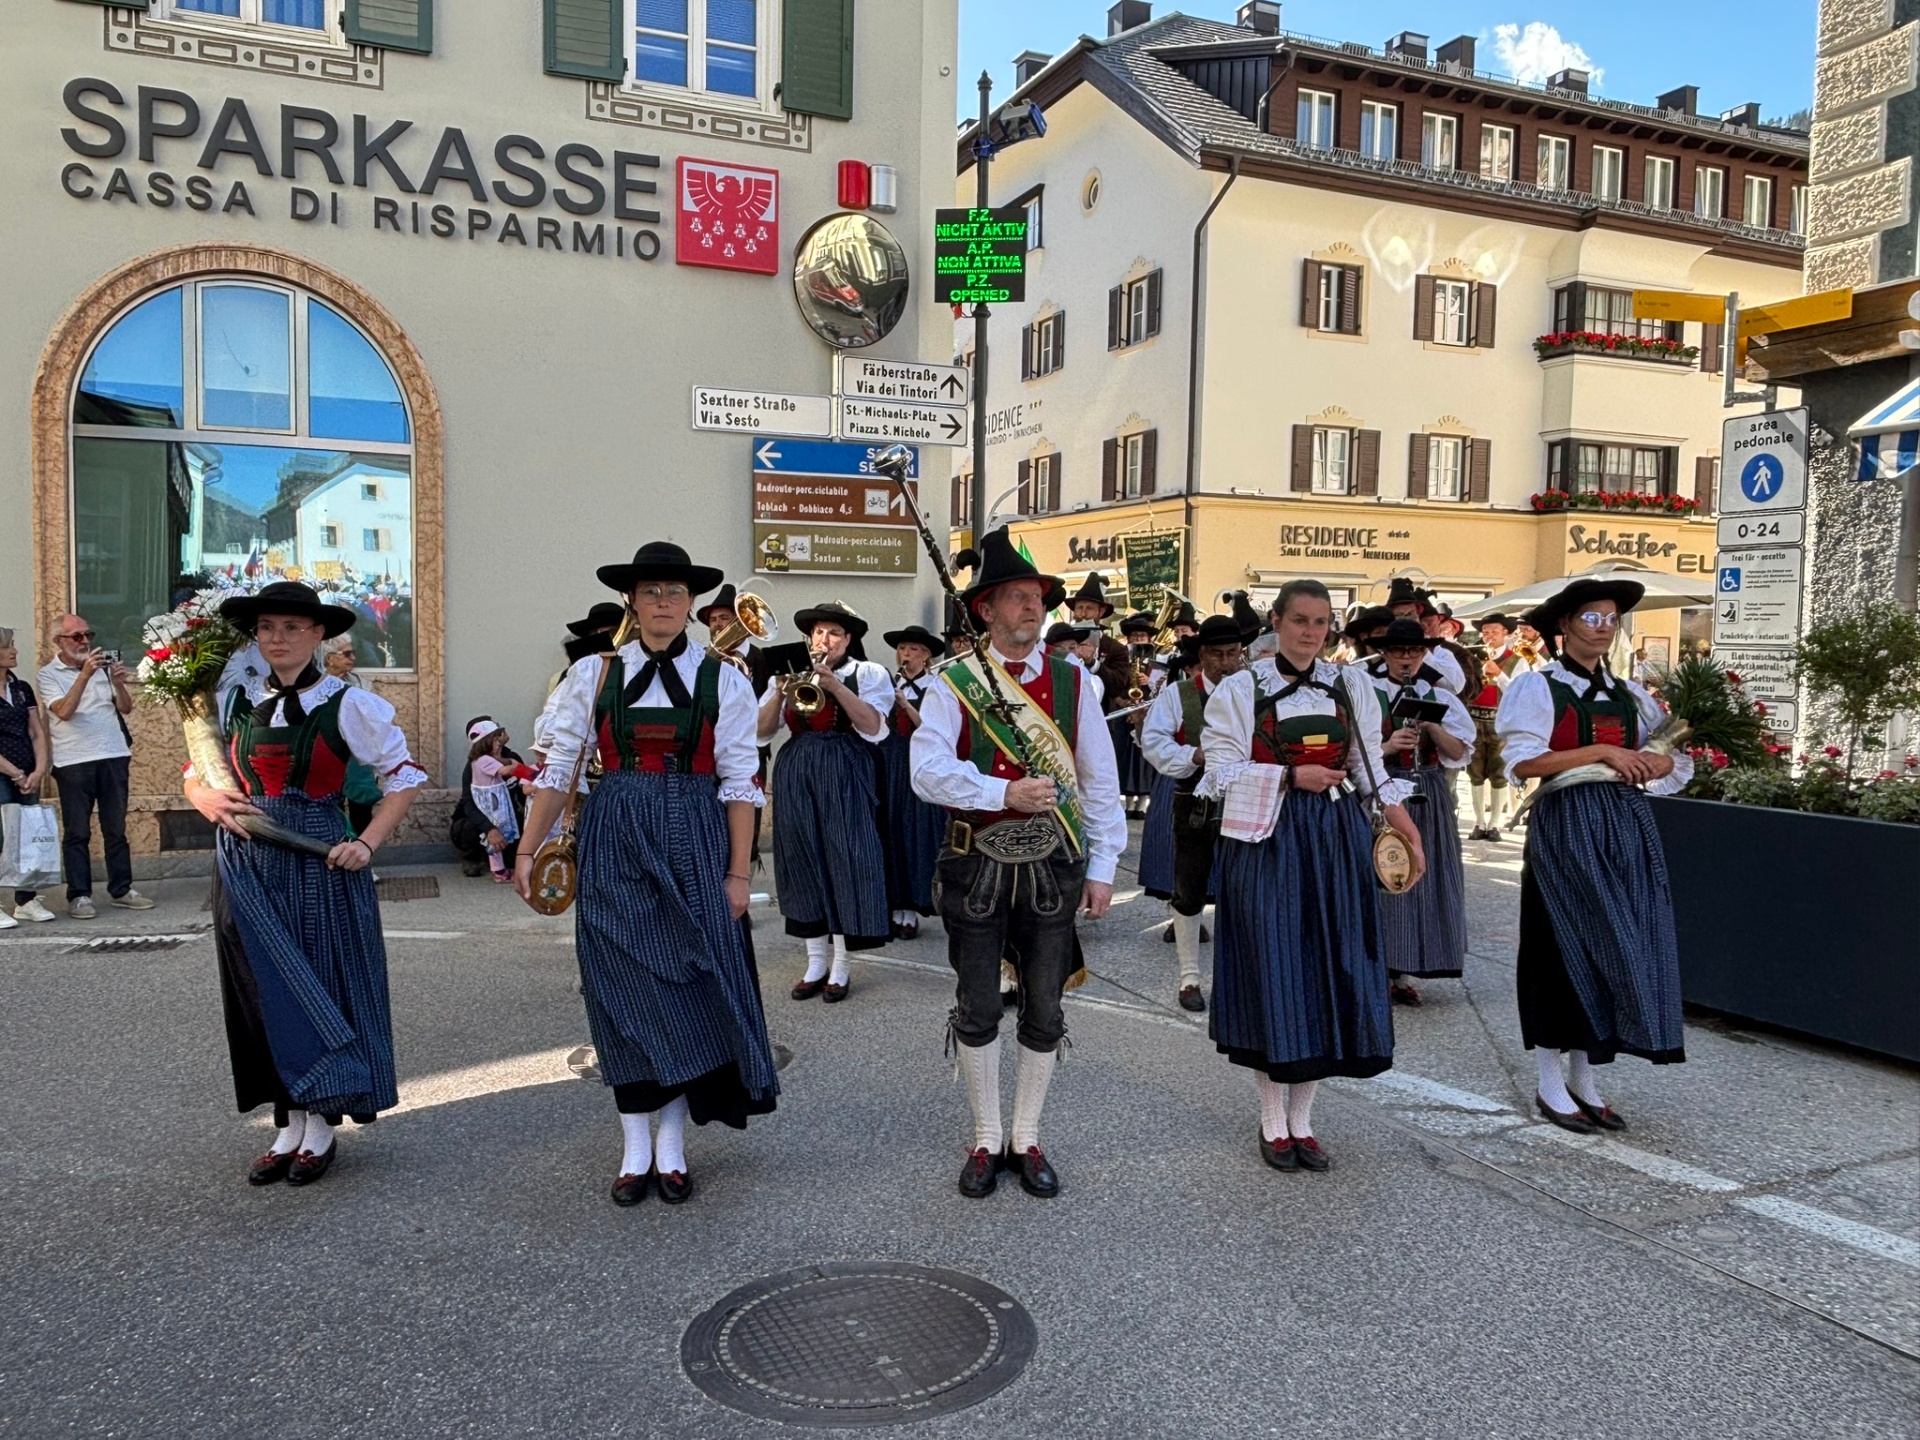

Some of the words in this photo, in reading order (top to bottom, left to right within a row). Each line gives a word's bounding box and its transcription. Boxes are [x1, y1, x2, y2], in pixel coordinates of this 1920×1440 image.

[60, 77, 661, 223] SPARKASSE
[61, 163, 256, 215] CASSA
[290, 188, 339, 225] DI
[374, 198, 661, 261] RISPARMIO
[968, 209, 994, 221] F.Z.
[936, 223, 980, 237] NICHT
[982, 222, 1026, 236] AKTIV
[967, 242, 994, 254] A.P.
[938, 256, 969, 268] NON
[973, 255, 1021, 268] ATTIVA
[967, 274, 993, 287] P.Z.
[950, 289, 1010, 302] OPENED
[863, 363, 938, 382] Färberstraße
[856, 380, 875, 394] Via
[879, 382, 896, 396] dei
[900, 384, 938, 399] Tintori
[700, 392, 749, 408] Sextner
[753, 396, 796, 411] Straße
[700, 410, 721, 424] Via
[725, 412, 760, 427] Sesto
[846, 404, 938, 422] St.-Michaels-Platz
[849, 422, 879, 435] Piazza
[1749, 420, 1778, 433] area
[1734, 431, 1794, 451] pedonale
[757, 501, 788, 512] Toblach
[799, 504, 834, 514] Dobbiaco
[1280, 524, 1378, 548] RESIDENCE
[1737, 521, 1781, 538] 0-24
[1568, 524, 1678, 559] Schäfer
[814, 553, 842, 564] Sexten
[857, 554, 879, 564] Sesto
[894, 556, 901, 566] 5
